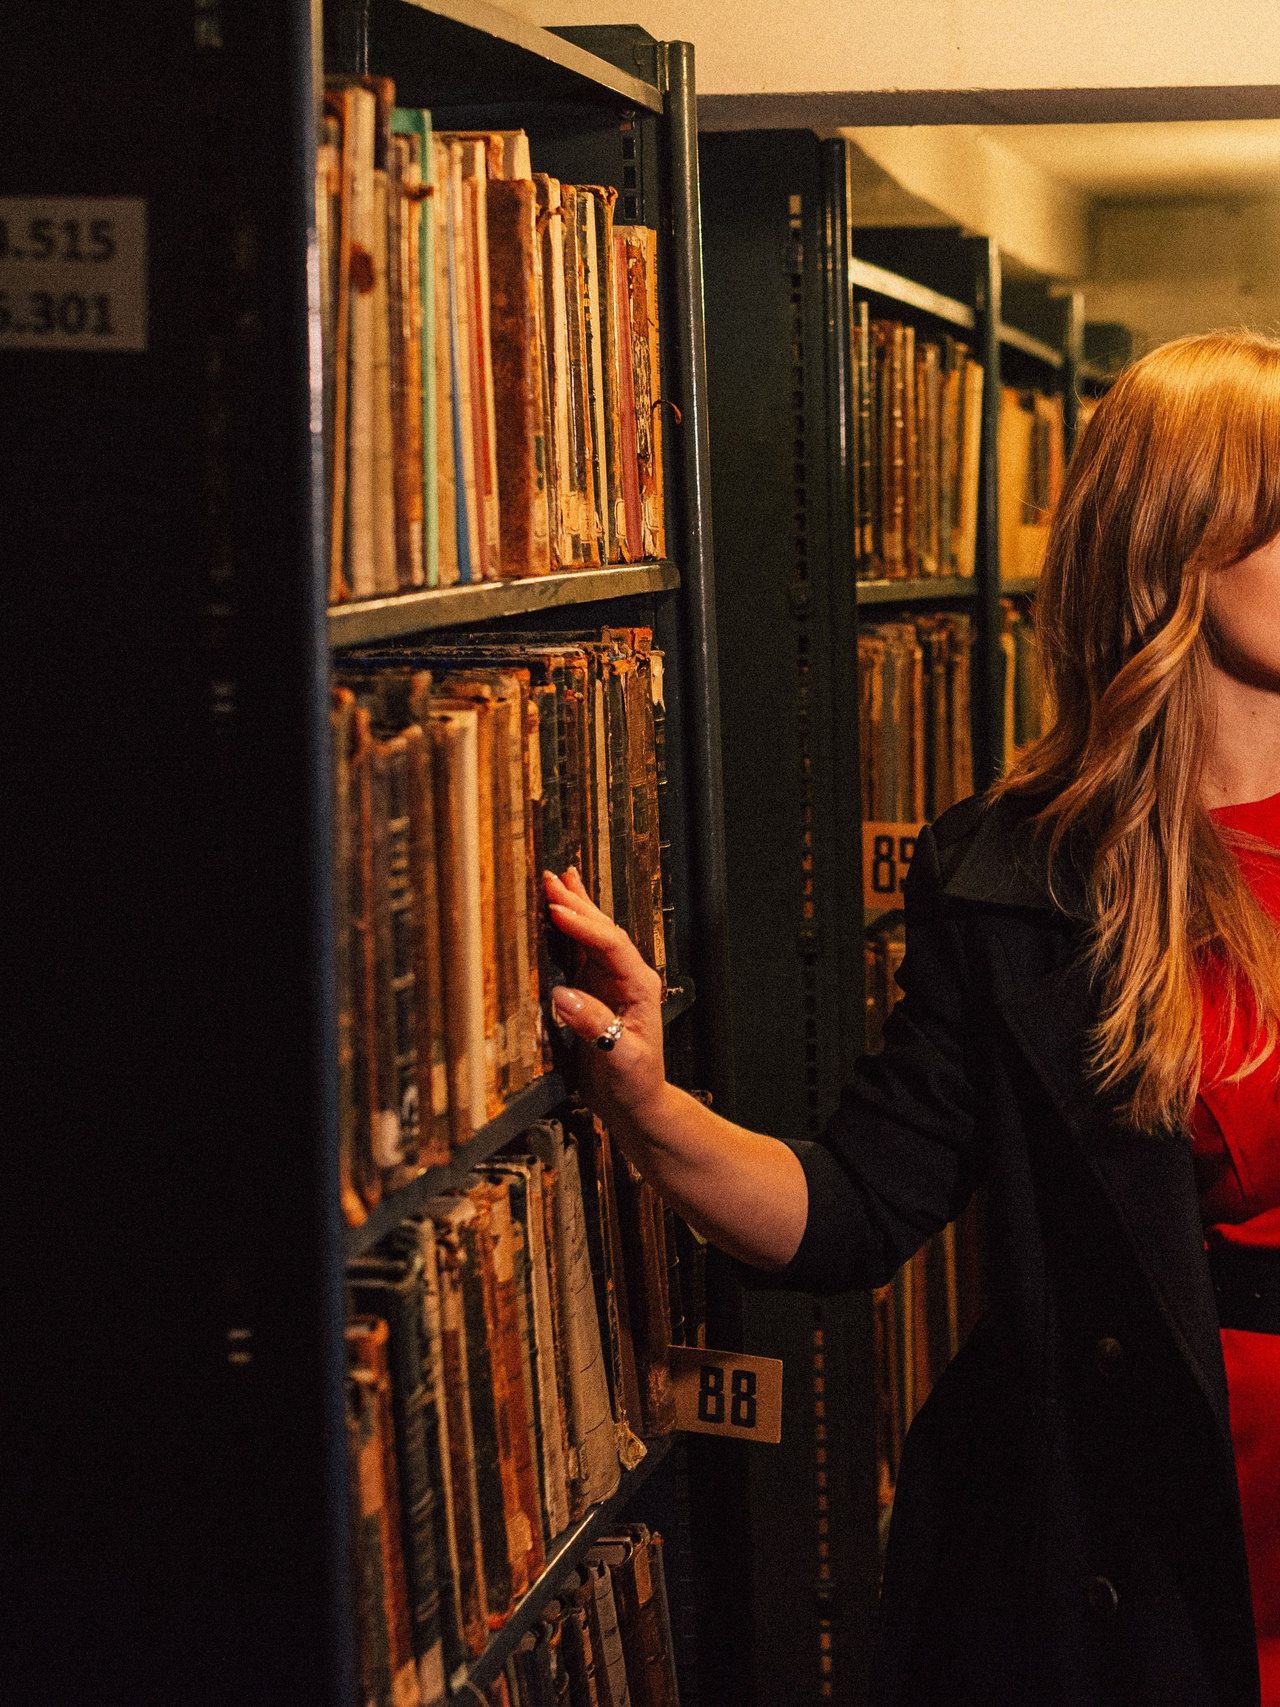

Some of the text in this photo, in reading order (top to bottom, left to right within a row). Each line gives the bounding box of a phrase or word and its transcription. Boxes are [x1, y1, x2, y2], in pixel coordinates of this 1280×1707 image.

[0, 216, 116, 262] .515
[0, 290, 114, 336] .301
[698, 1365, 757, 1429] 88
